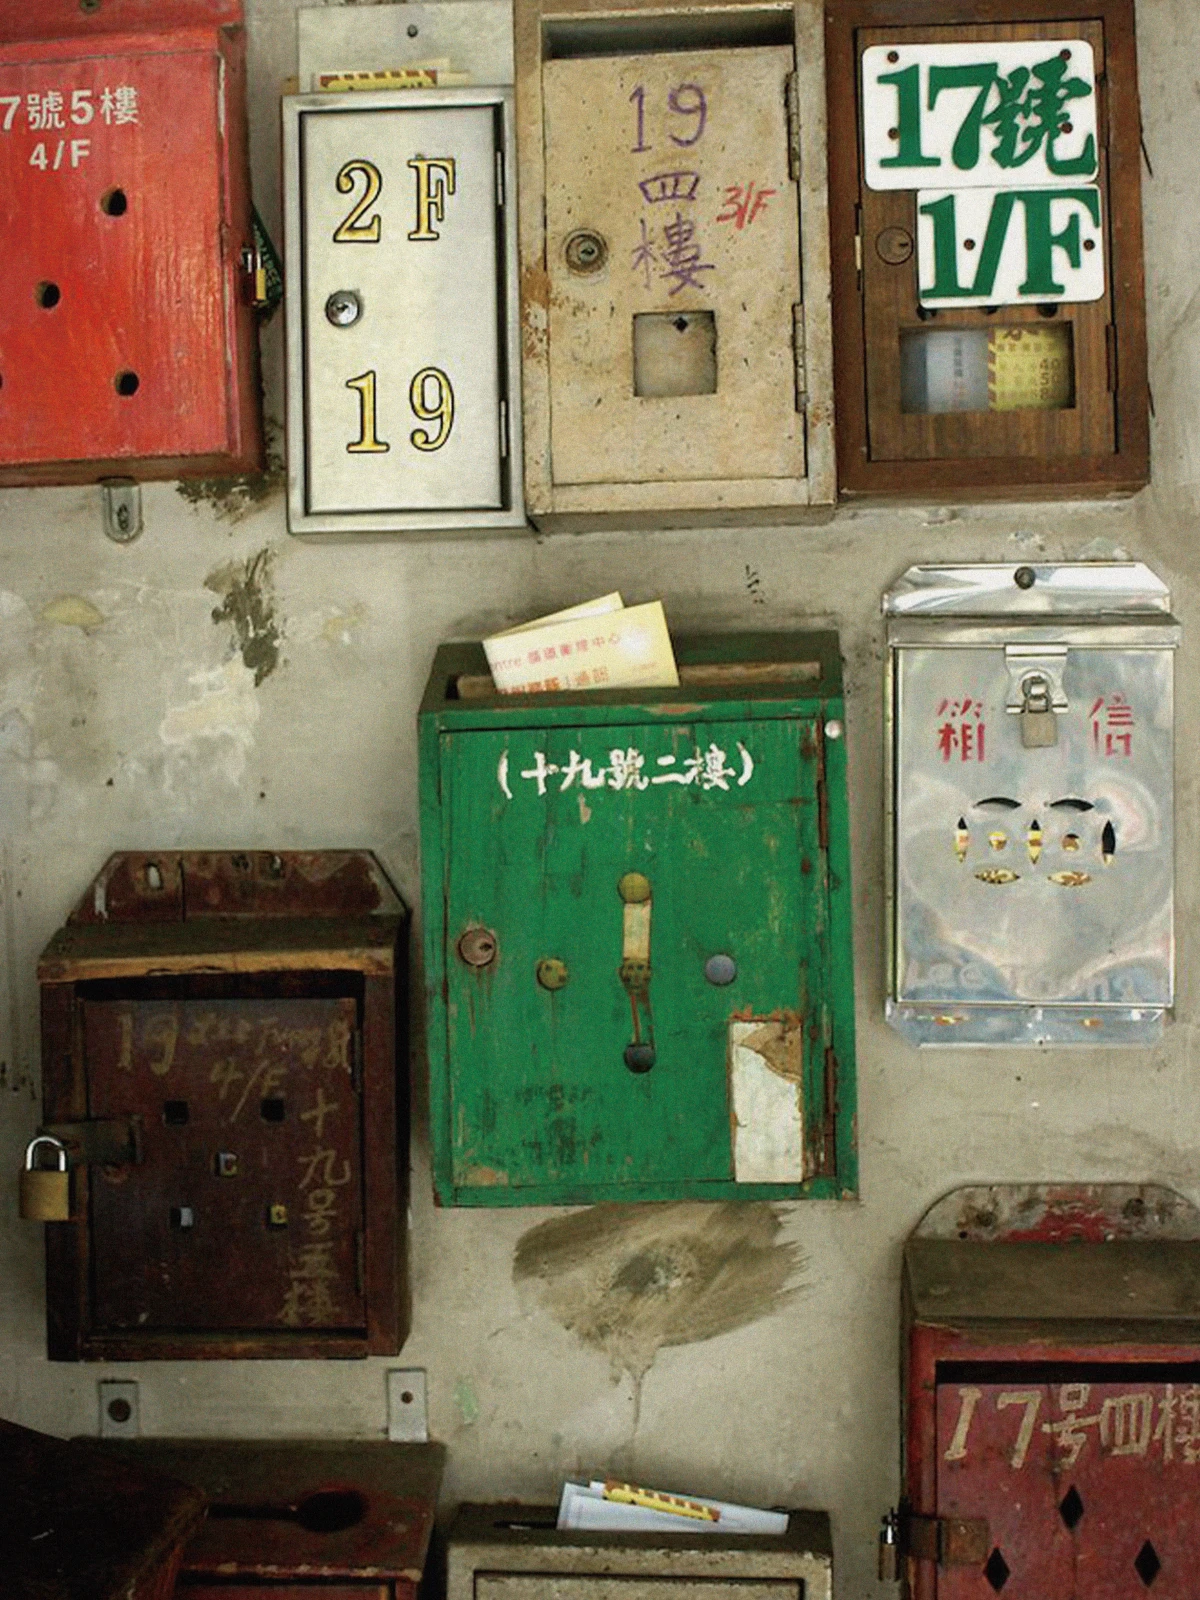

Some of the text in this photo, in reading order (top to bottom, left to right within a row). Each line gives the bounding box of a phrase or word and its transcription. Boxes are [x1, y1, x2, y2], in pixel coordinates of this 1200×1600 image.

[29, 139, 91, 171] 4/F
[715, 181, 777, 230] 3/F
[919, 188, 1101, 299] 1/F
[345, 366, 455, 454] 19
